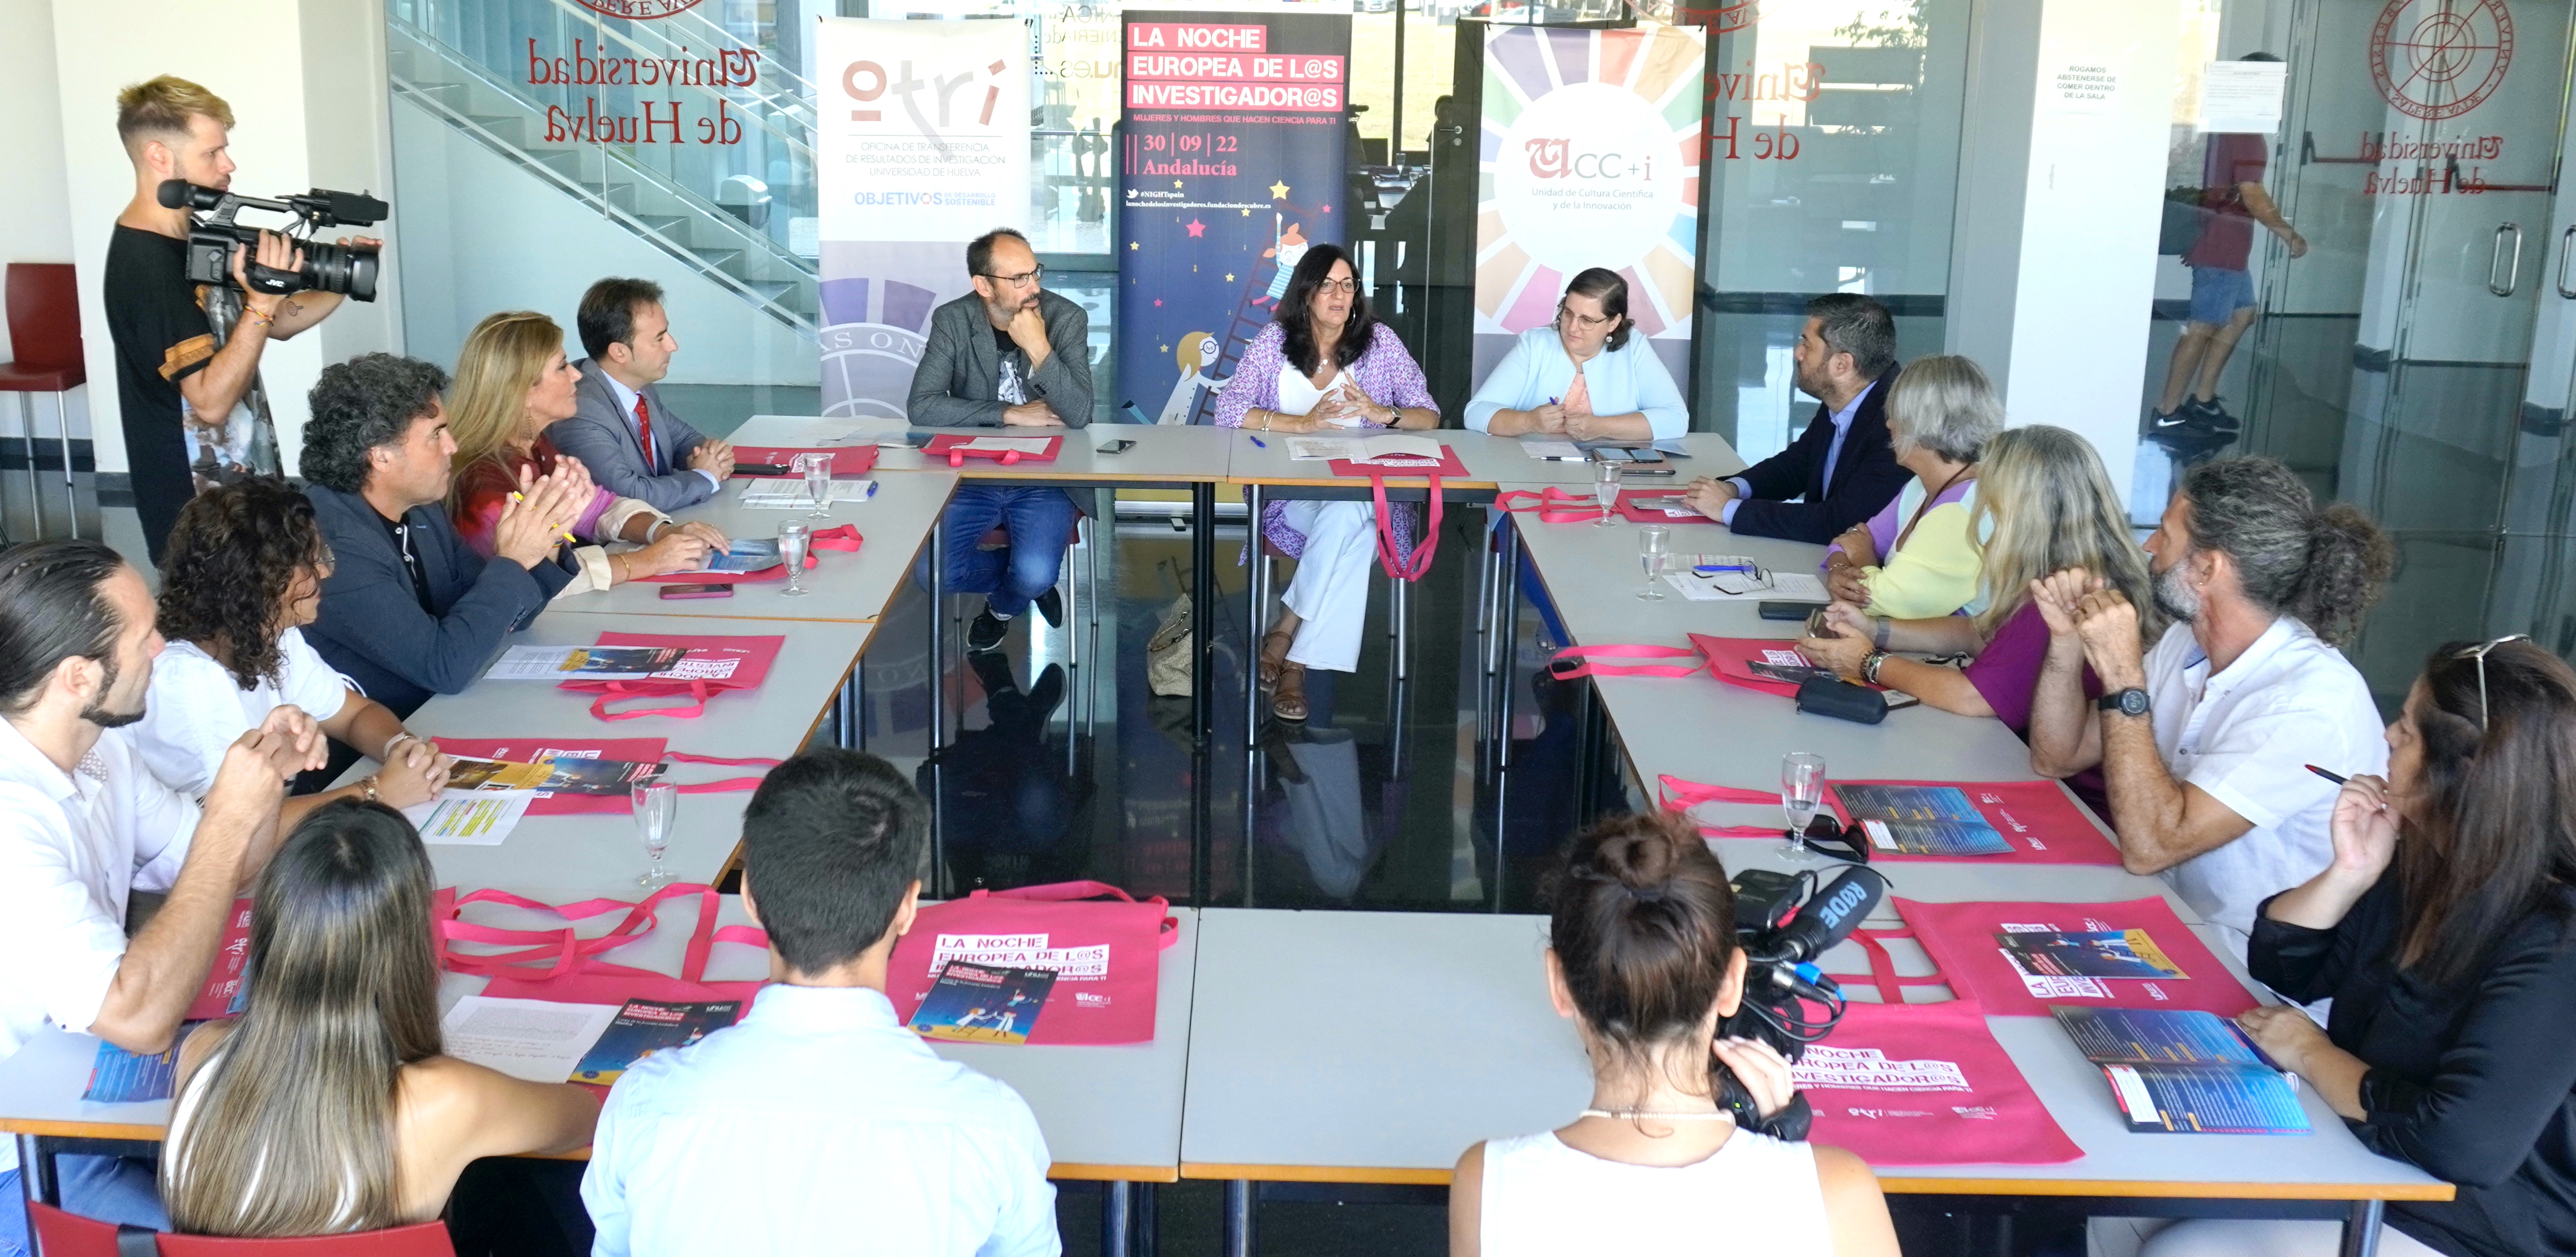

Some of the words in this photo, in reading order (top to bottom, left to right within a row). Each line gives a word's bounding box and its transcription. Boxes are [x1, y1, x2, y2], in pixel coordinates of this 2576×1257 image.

[1133, 27, 1165, 47] LA
[1177, 27, 1261, 49] NOCHE
[1133, 55, 1243, 77] EUROPEA
[1253, 58, 1283, 78] DE
[1290, 58, 1338, 79] L@S
[2056, 74, 2104, 82] ABSTENERSE
[1133, 84, 1338, 108] INVESTIGADOR@S
[1133, 114, 1172, 122] MUJERES
[861, 142, 900, 151] OFICINA
[902, 142, 915, 151] DE
[916, 142, 990, 152] TRANSFERENCIA
[1143, 134, 1166, 152] 30
[1180, 135, 1202, 152] 09
[1216, 135, 1238, 152] 22
[846, 155, 859, 164] DE
[860, 155, 916, 164] RESULTADOS
[919, 155, 932, 164] DE
[932, 154, 1006, 165] INVESTIGACIÓN
[869, 167, 931, 177] UNIVERSIDAD
[933, 168, 945, 176] DE
[947, 168, 981, 177] HUELVA
[1143, 159, 1238, 177] Andalucía
[854, 192, 943, 205] OBJETIVOS
[1532, 187, 1563, 196] Unidad
[1579, 189, 1610, 198] Cultura
[1613, 189, 1653, 198] Científica
[1125, 200, 1271, 210] lanochedelosinvestigadores.fundaciondescubre.es
[265, 279, 285, 288] JVC
[941, 938, 966, 948] LA
[976, 937, 1043, 949] NOCHE
[938, 952, 1027, 963] EUROPEA
[1035, 951, 1060, 961] DE
[1065, 949, 1104, 961] L@S
[1805, 1046, 1879, 1059] NOCHE
[1793, 1057, 1870, 1071] ROPEA
[1878, 1061, 1904, 1072] DE
[1909, 1062, 1954, 1072] L@S
